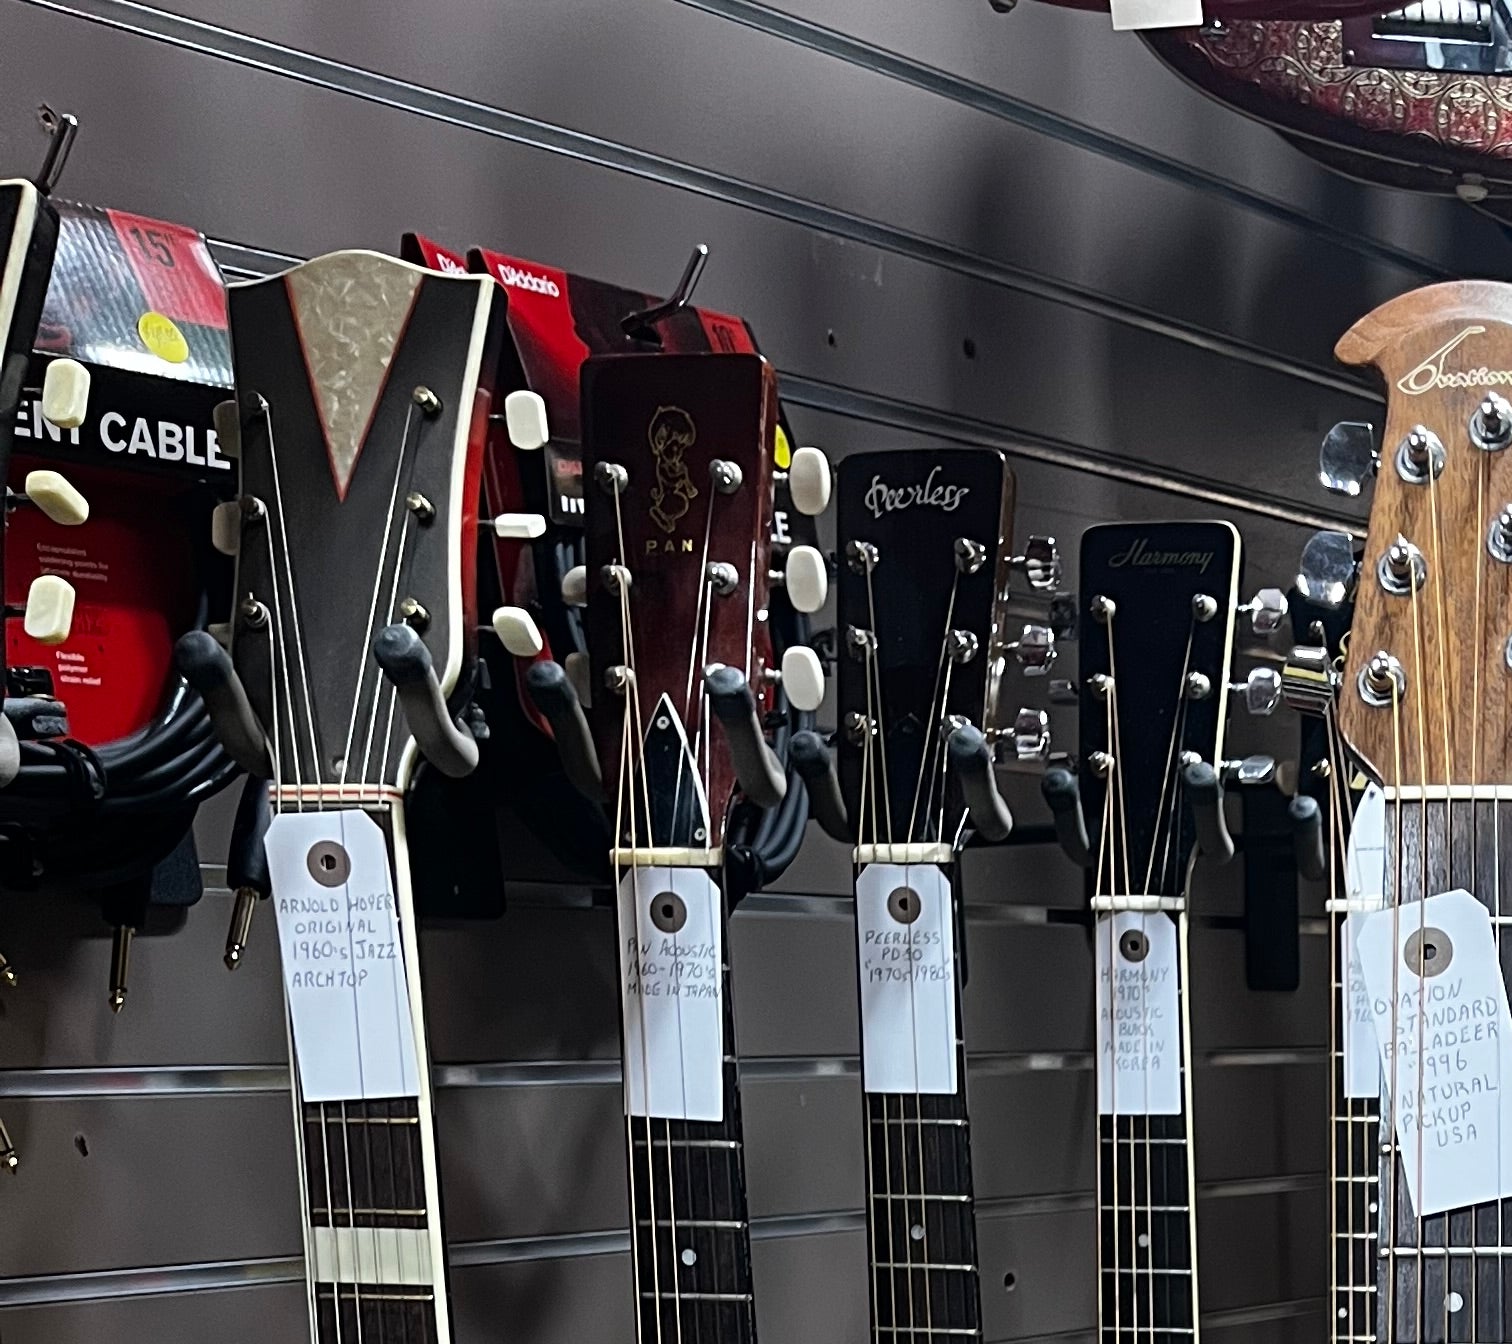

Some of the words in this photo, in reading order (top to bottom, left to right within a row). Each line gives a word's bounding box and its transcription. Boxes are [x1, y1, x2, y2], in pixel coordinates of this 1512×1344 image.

[497, 263, 560, 298] D'Addario
[99, 411, 231, 470] CABLE
[864, 465, 970, 519] Peerless
[646, 539, 693, 554] PAN
[1108, 538, 1214, 575] Harmony
[279, 898, 339, 914] ARNOLD
[349, 893, 394, 912] HOYER
[295, 919, 376, 934] ORIGINAL
[865, 930, 941, 945] PEERLESS
[355, 939, 397, 960] JAZZ
[627, 982, 660, 996] MDE
[1374, 978, 1463, 1016] OVATION
[1101, 1007, 1164, 1020] AOUSTIC
[1396, 996, 1498, 1035] STANDARD
[1402, 1101, 1471, 1134] PICKUP
[1437, 1123, 1478, 1148] USA
